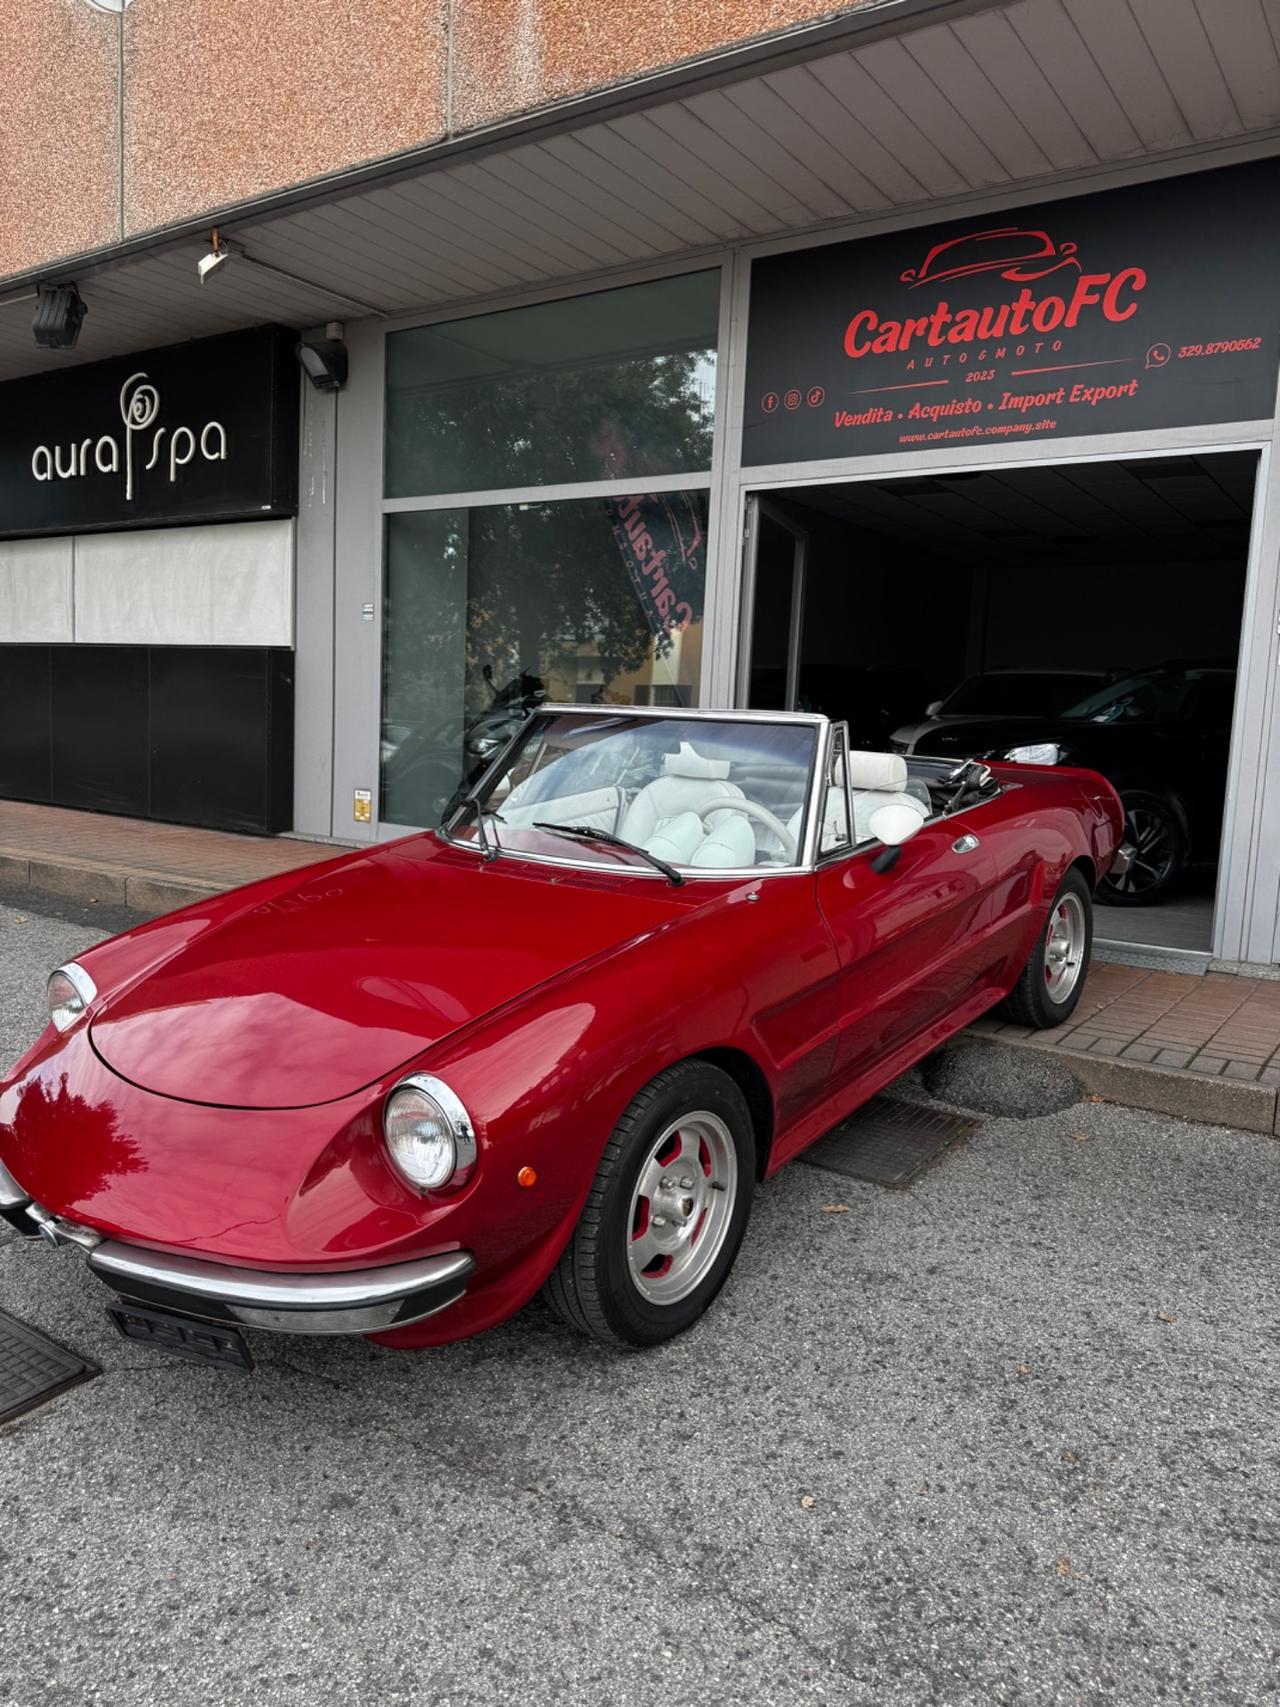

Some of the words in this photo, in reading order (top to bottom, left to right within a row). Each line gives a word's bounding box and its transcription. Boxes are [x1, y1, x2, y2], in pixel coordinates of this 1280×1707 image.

[844, 267, 1147, 359] CartautoFC
[1178, 337, 1262, 359] 329.8790562
[965, 369, 996, 384] 2023
[834, 407, 893, 429] Vendita
[908, 399, 982, 423] Acquisto
[998, 386, 1065, 413] Import
[1069, 378, 1139, 405] Export
[899, 419, 1057, 444] www.cartautofc.company.site
[32, 435, 119, 481] aura
[145, 421, 227, 483] spa
